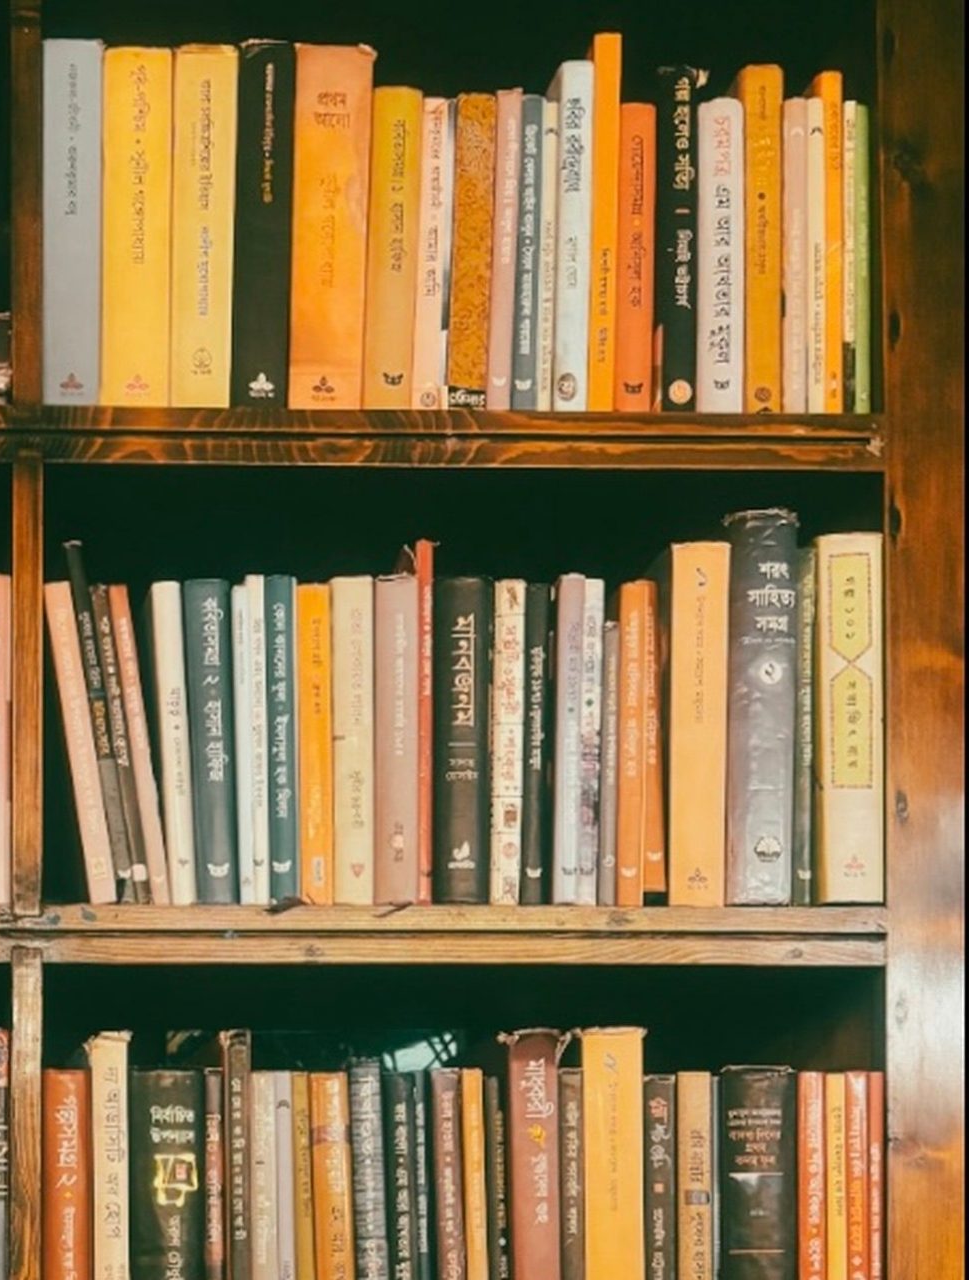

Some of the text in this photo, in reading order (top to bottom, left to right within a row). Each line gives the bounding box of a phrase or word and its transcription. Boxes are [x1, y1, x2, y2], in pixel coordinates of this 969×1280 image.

[129, 150, 148, 185] সুনীল
[715, 185, 730, 209] এম
[715, 216, 730, 246] আর
[628, 285, 642, 307] হক
[713, 254, 731, 318] আখতার
[708, 324, 730, 363] মুকুল
[757, 561, 790, 580] শরৎ
[452, 612, 476, 727] মানবজনম
[206, 700, 223, 735] হাসান
